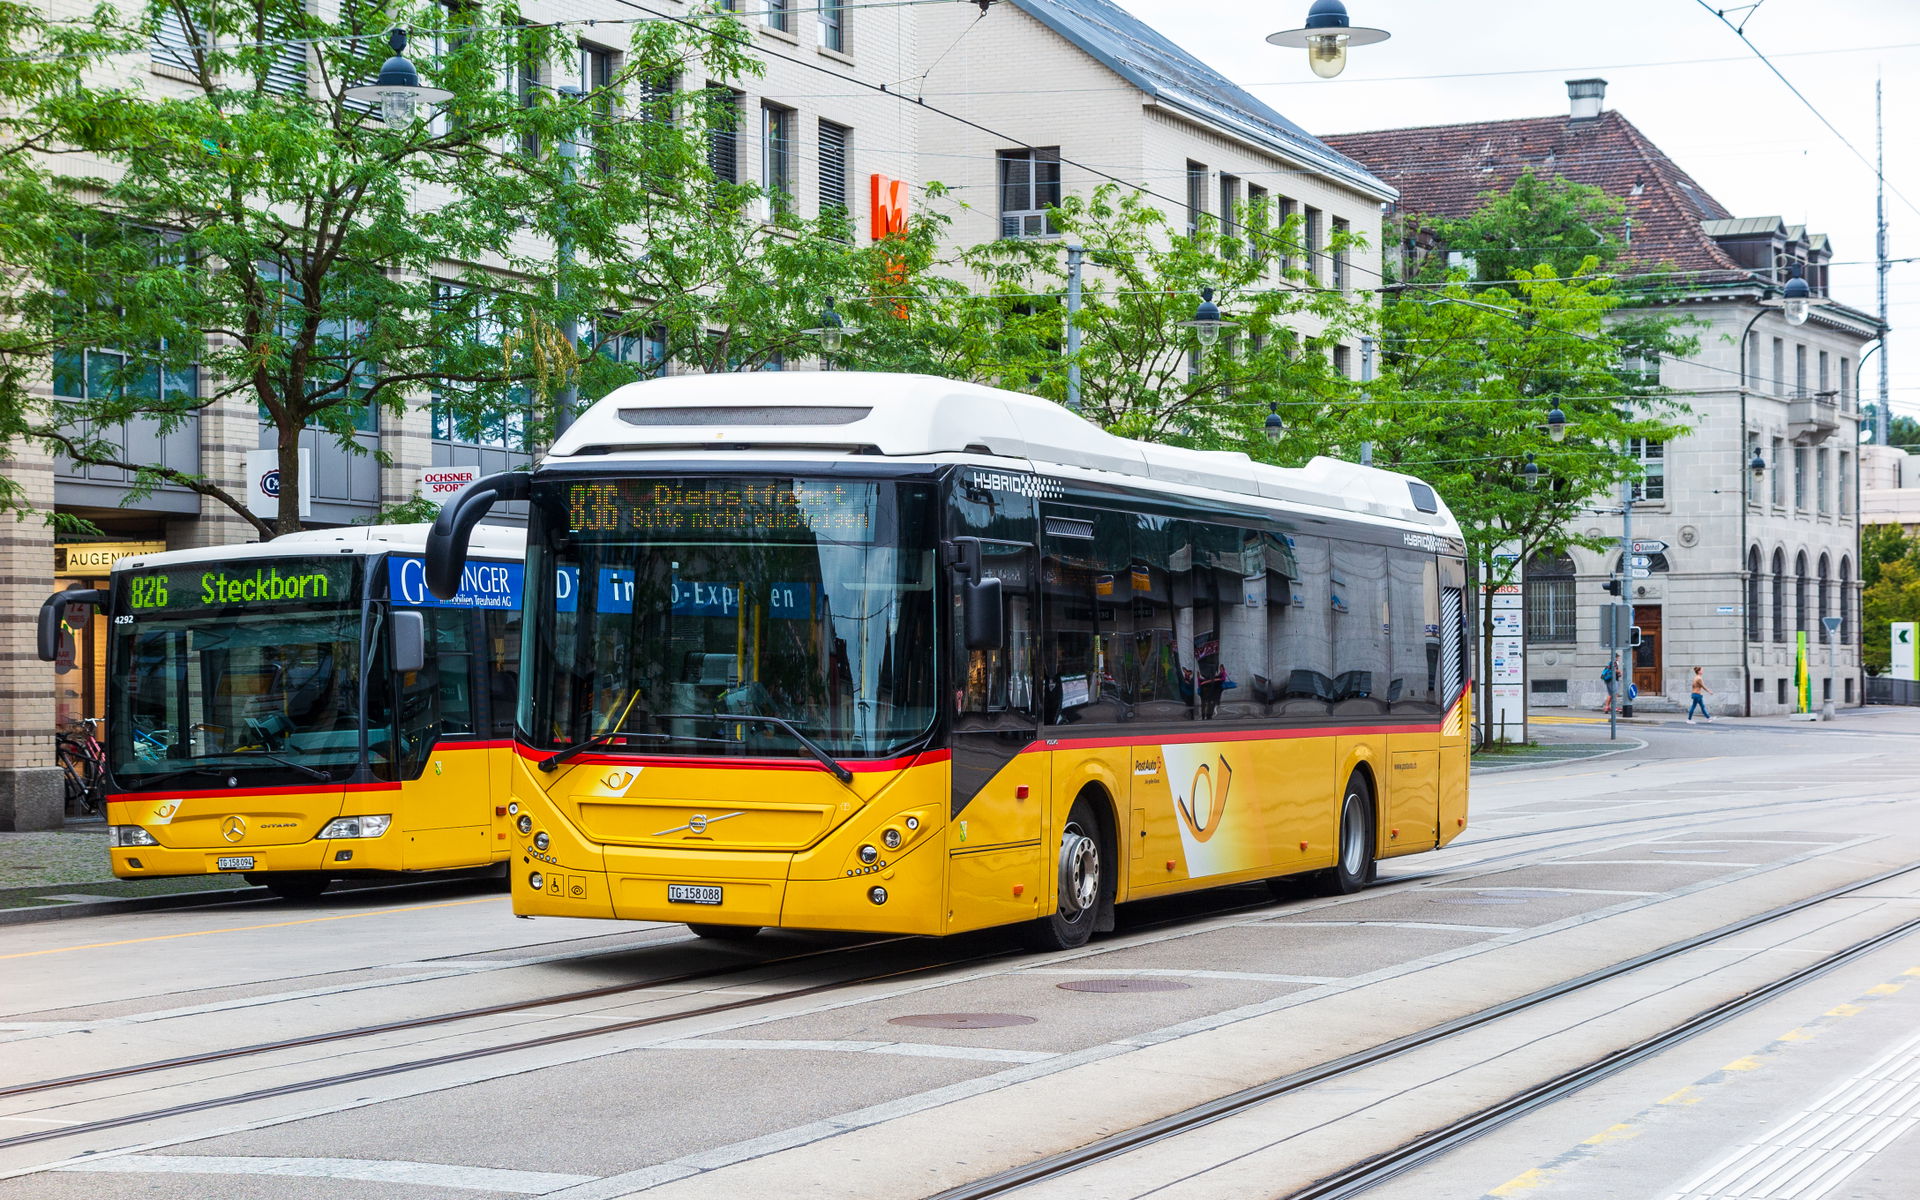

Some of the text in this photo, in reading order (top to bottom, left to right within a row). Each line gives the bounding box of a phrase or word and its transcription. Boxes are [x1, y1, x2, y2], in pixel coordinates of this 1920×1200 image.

[425, 473, 472, 482] OCHSNER
[973, 472, 1020, 493] HYBRID
[570, 485, 618, 530] 836
[633, 508, 683, 528] Bitte
[692, 507, 745, 528] nicht
[131, 568, 328, 608] 826 Steckborn
[474, 595, 500, 606] Treuhand
[501, 596, 512, 607] AG
[114, 615, 134, 624] 4292
